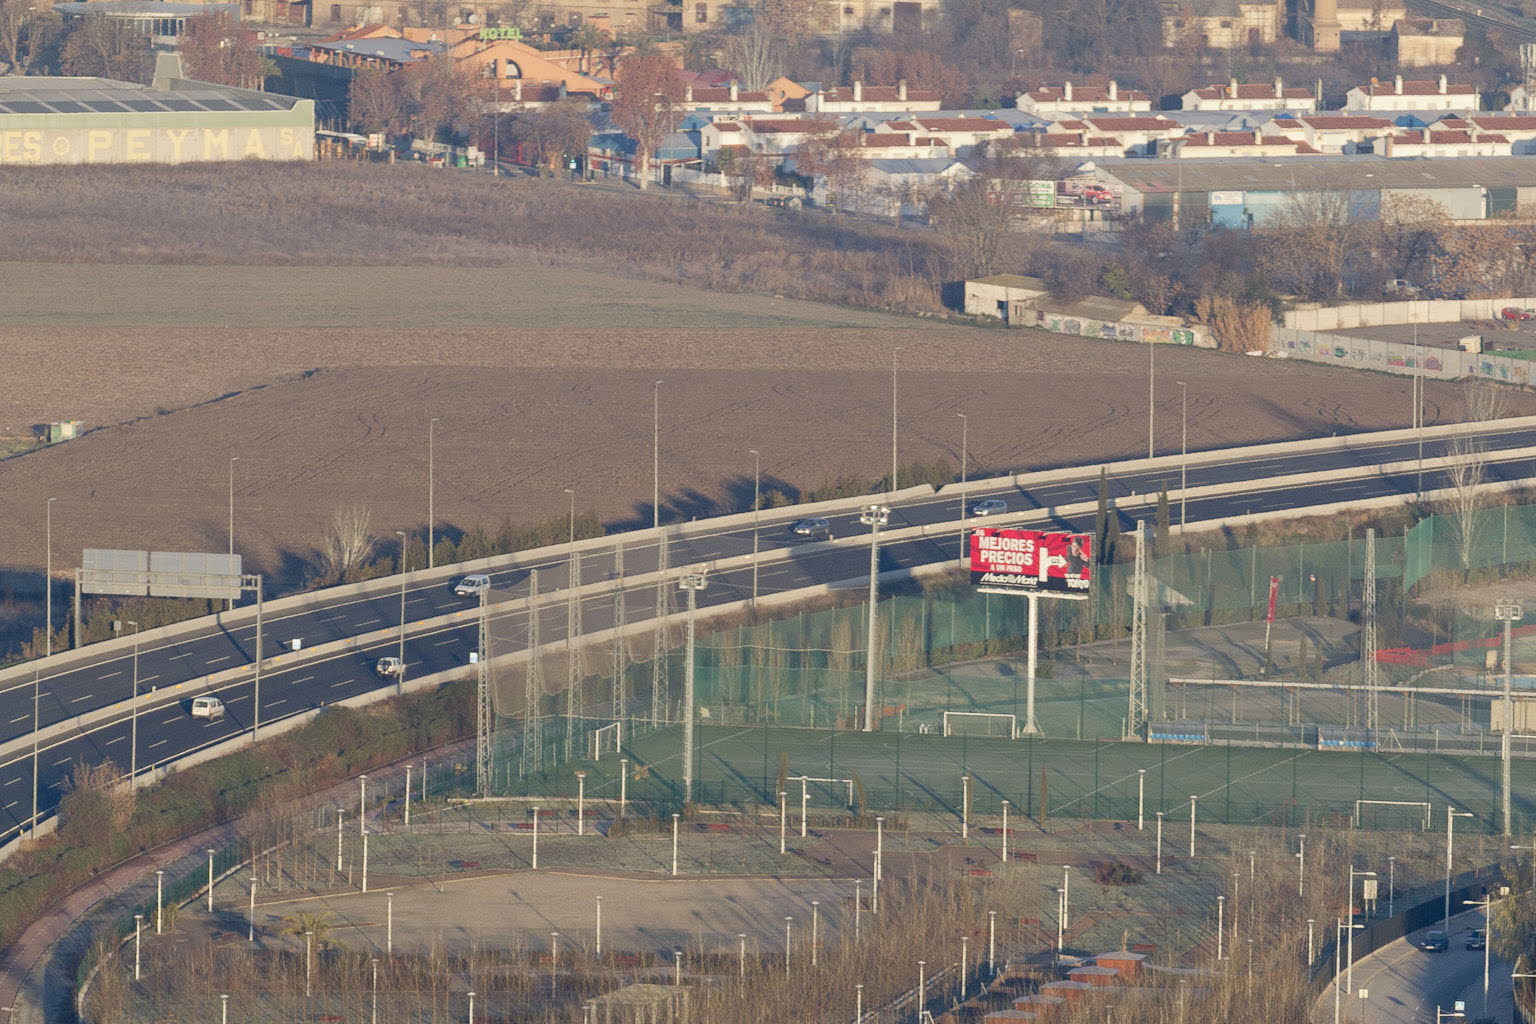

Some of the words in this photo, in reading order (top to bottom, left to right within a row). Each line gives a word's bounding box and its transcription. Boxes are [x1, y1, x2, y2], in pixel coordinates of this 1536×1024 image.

[480, 27, 523, 40] HOTEL
[87, 129, 265, 160] PEYMA
[979, 536, 1035, 553] MEJORES
[980, 550, 1034, 566] PRECIOS
[1006, 565, 1023, 573] PASO
